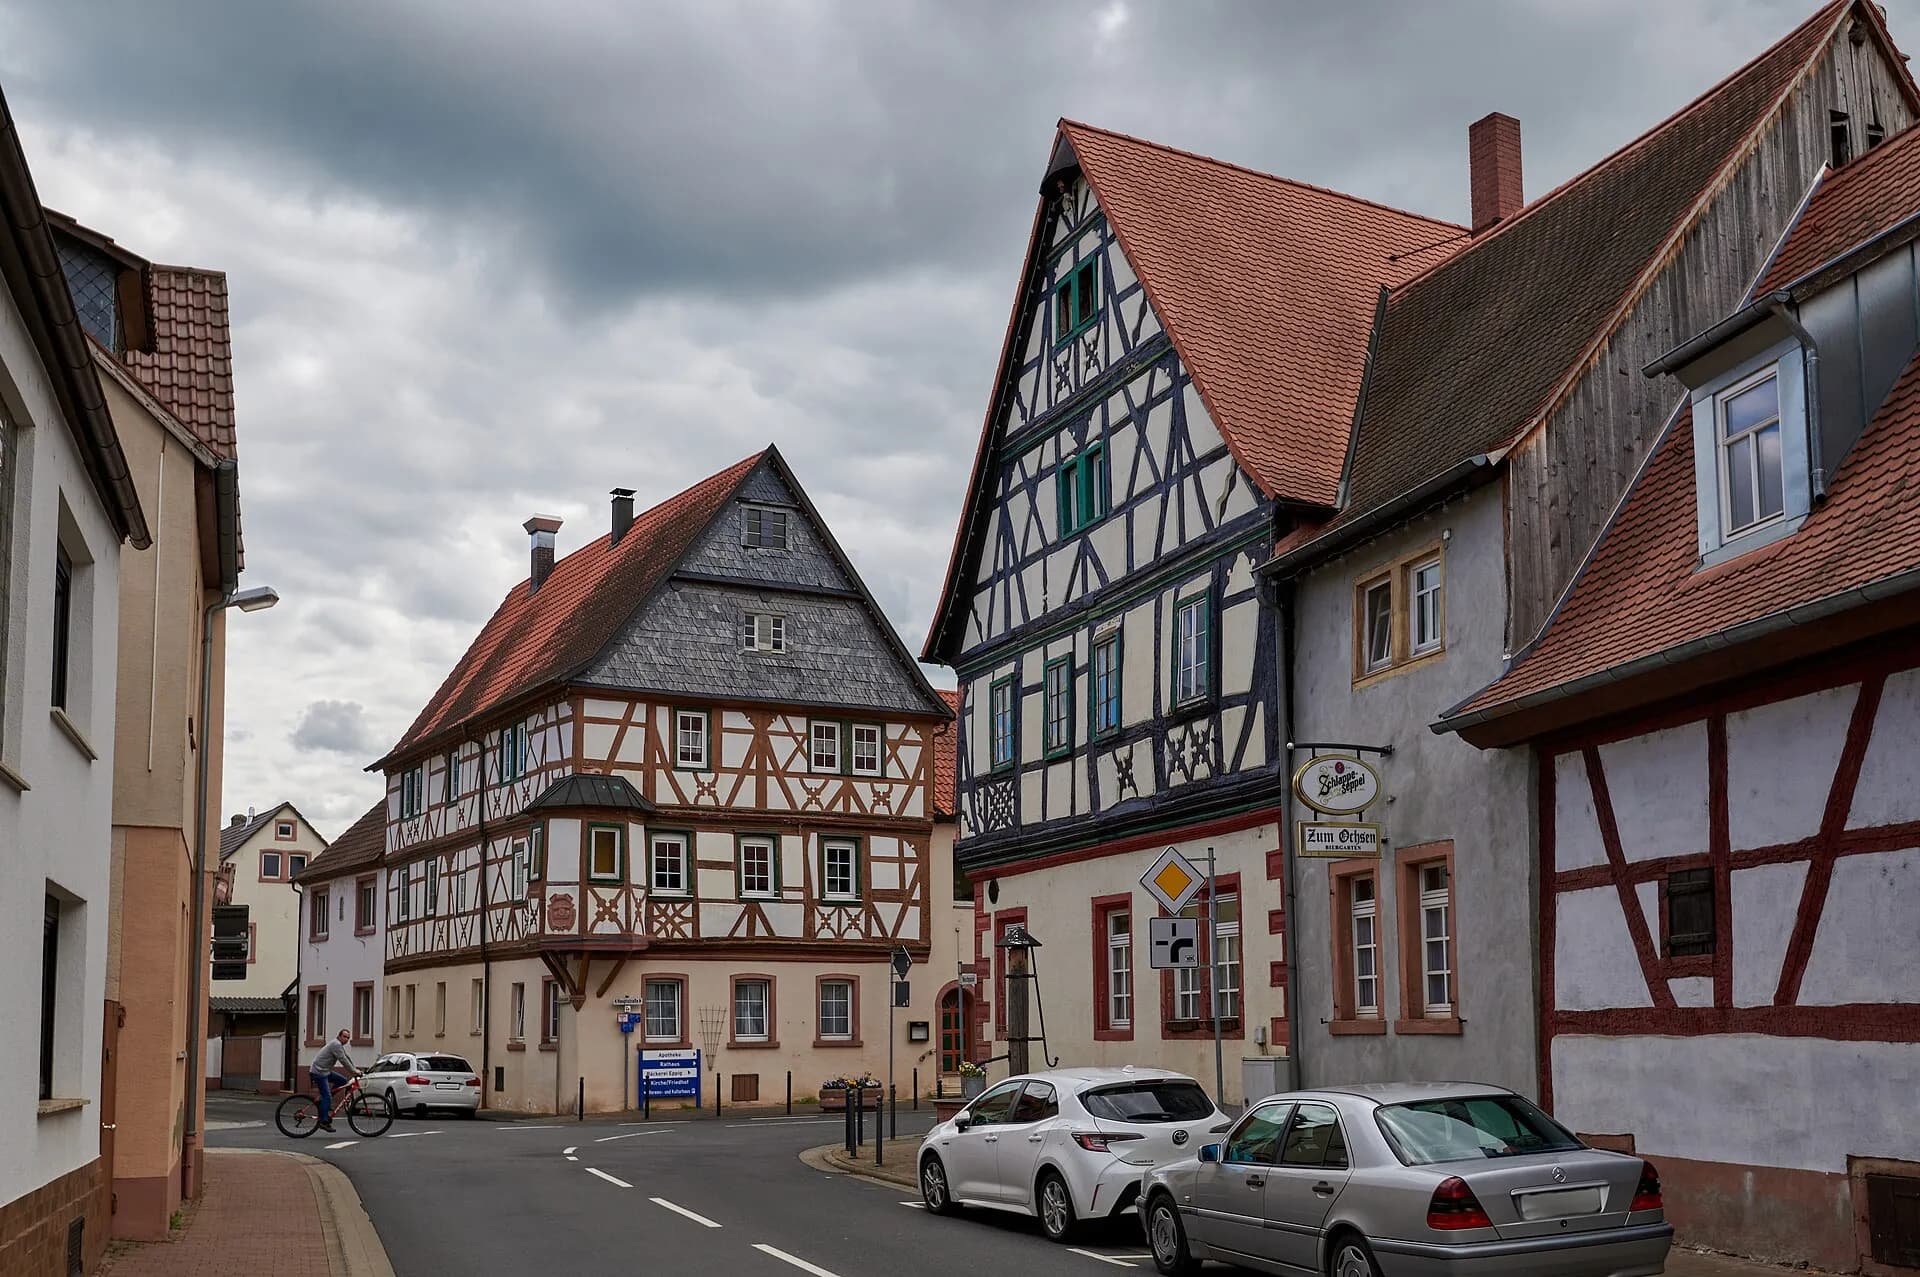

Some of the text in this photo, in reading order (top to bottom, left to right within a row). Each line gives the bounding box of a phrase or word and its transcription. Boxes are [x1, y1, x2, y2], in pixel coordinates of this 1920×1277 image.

[1318, 770, 1358, 796] Schlappe-
[1307, 828, 1376, 845] Zum Ochsen
